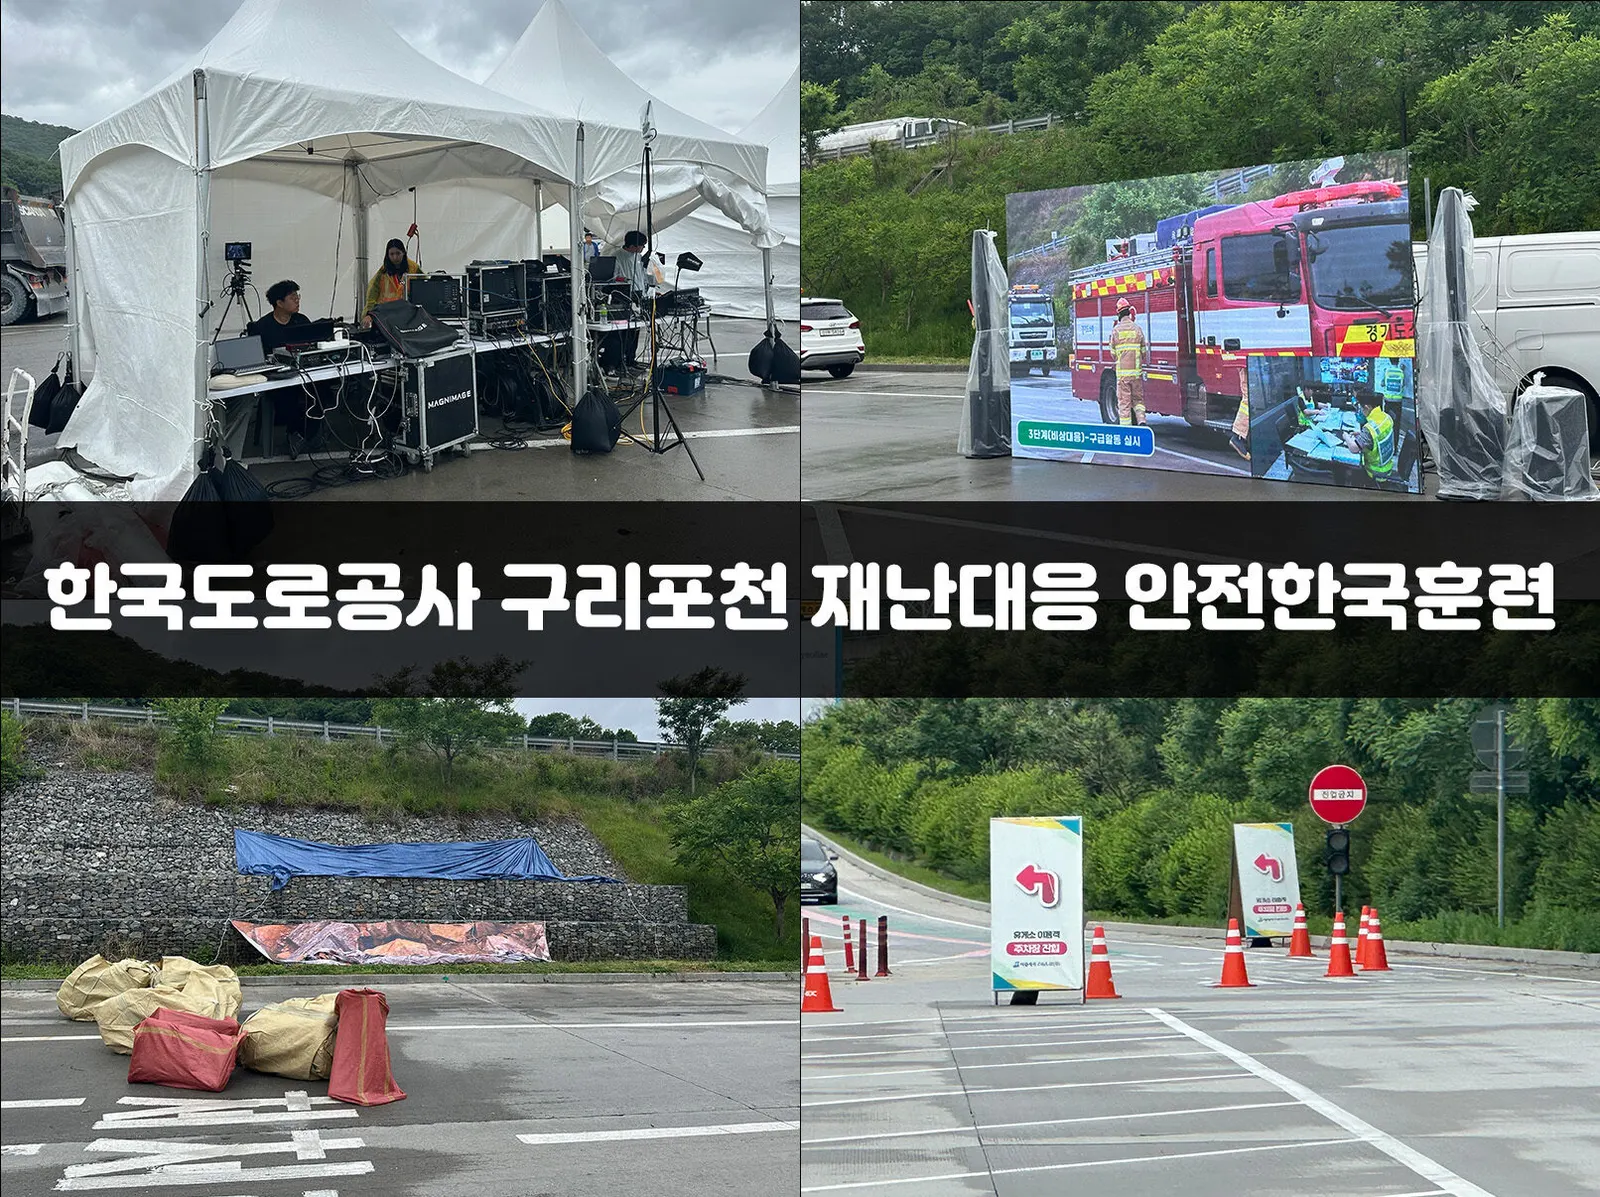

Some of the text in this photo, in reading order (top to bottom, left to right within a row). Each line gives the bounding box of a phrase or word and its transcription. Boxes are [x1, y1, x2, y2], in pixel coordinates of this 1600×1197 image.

[427, 389, 472, 410] MAGNIMAGE
[1028, 428, 1141, 447] 3단계(비상대응)-구급활동 실시
